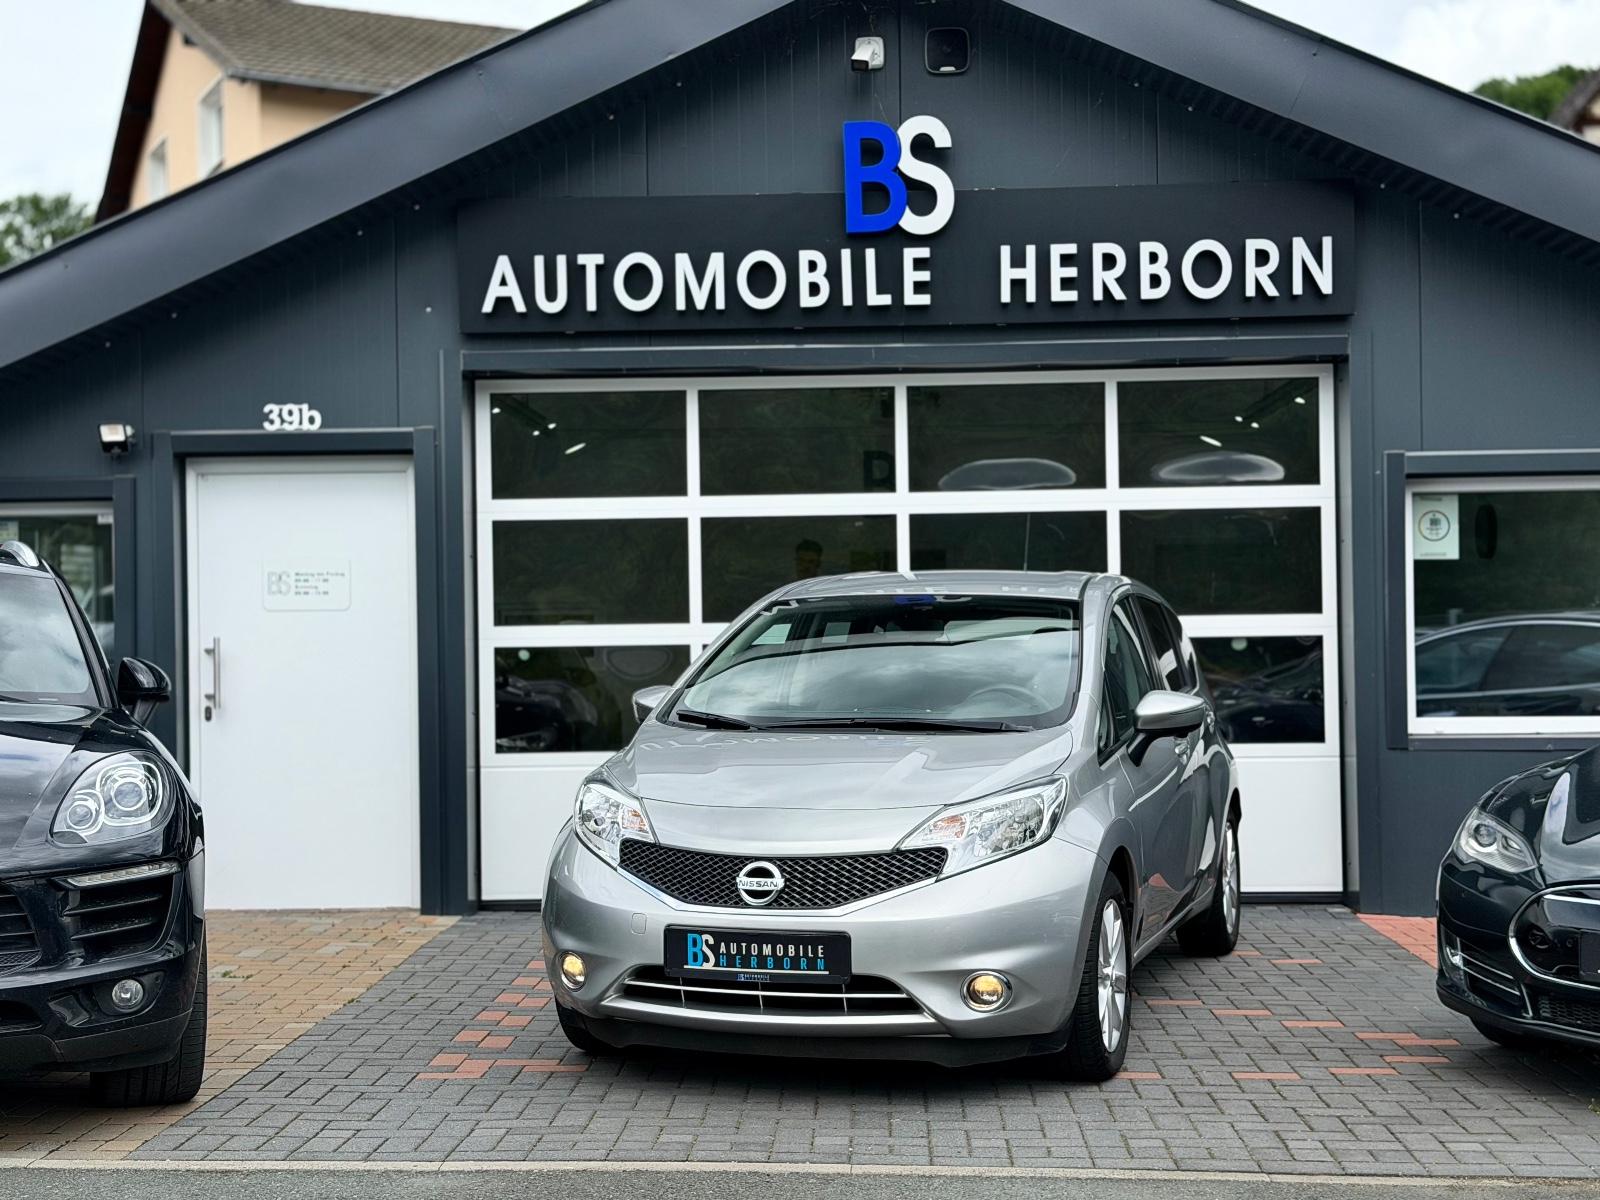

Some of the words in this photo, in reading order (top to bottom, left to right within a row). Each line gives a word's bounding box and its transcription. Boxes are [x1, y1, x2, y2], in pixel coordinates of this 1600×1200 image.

[843, 115, 955, 235] BS
[482, 247, 931, 314] AUTOMOBILE
[1000, 236, 1333, 303] HERBORN
[262, 403, 321, 431] 39b
[738, 879, 778, 888] NISSAN
[687, 933, 716, 968] BS
[719, 942, 824, 957] AUTOMOBILE
[719, 955, 825, 970] HERBORN
